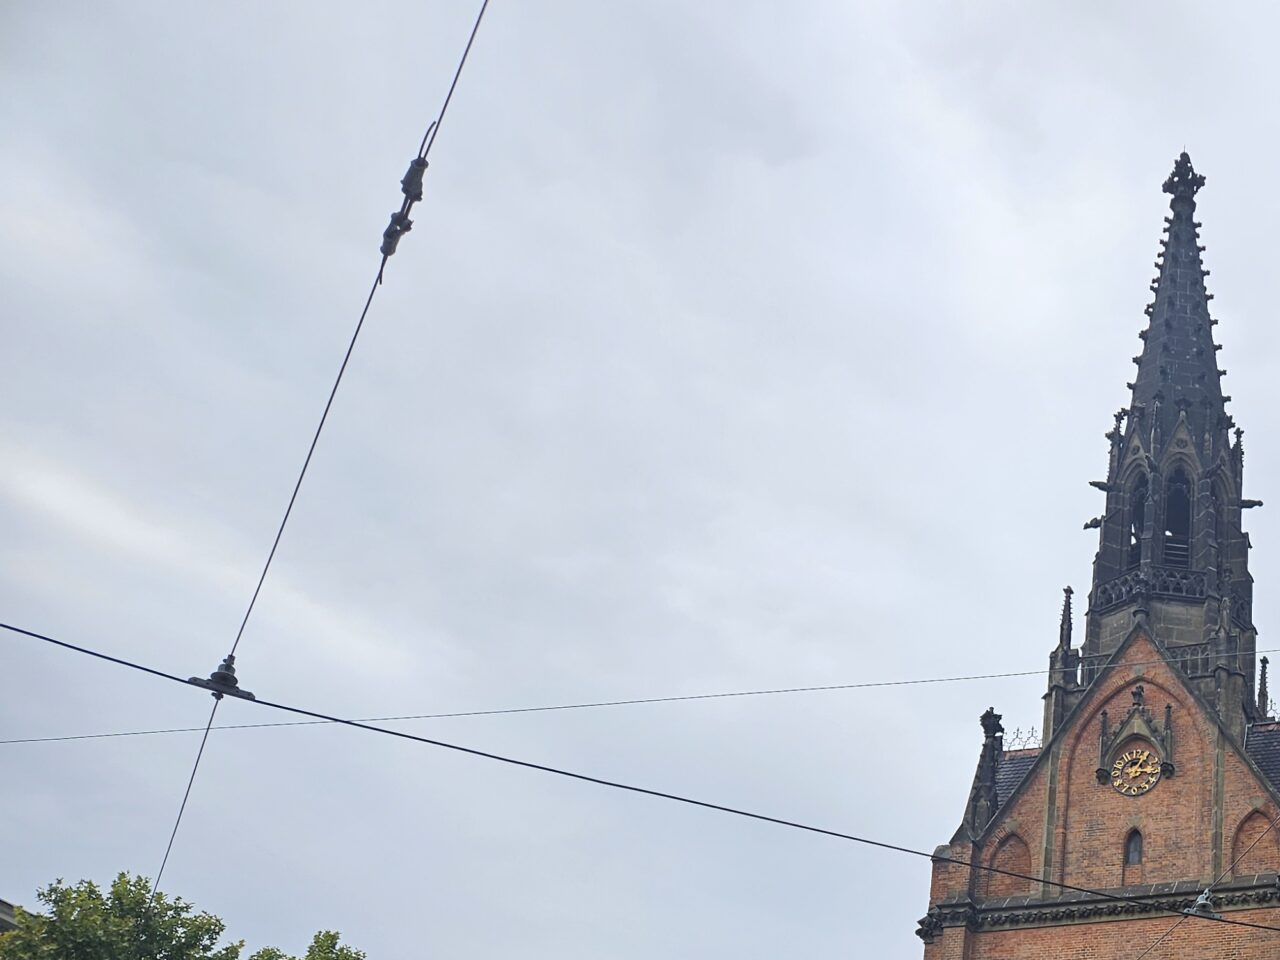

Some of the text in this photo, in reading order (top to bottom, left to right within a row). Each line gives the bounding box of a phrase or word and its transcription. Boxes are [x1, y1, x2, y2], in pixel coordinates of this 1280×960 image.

[1123, 753, 1131, 762] 11
[1114, 761, 1124, 770] 10
[1149, 776, 1157, 784] 4
[1121, 784, 1129, 792] 7
[1141, 782, 1149, 791] 5
